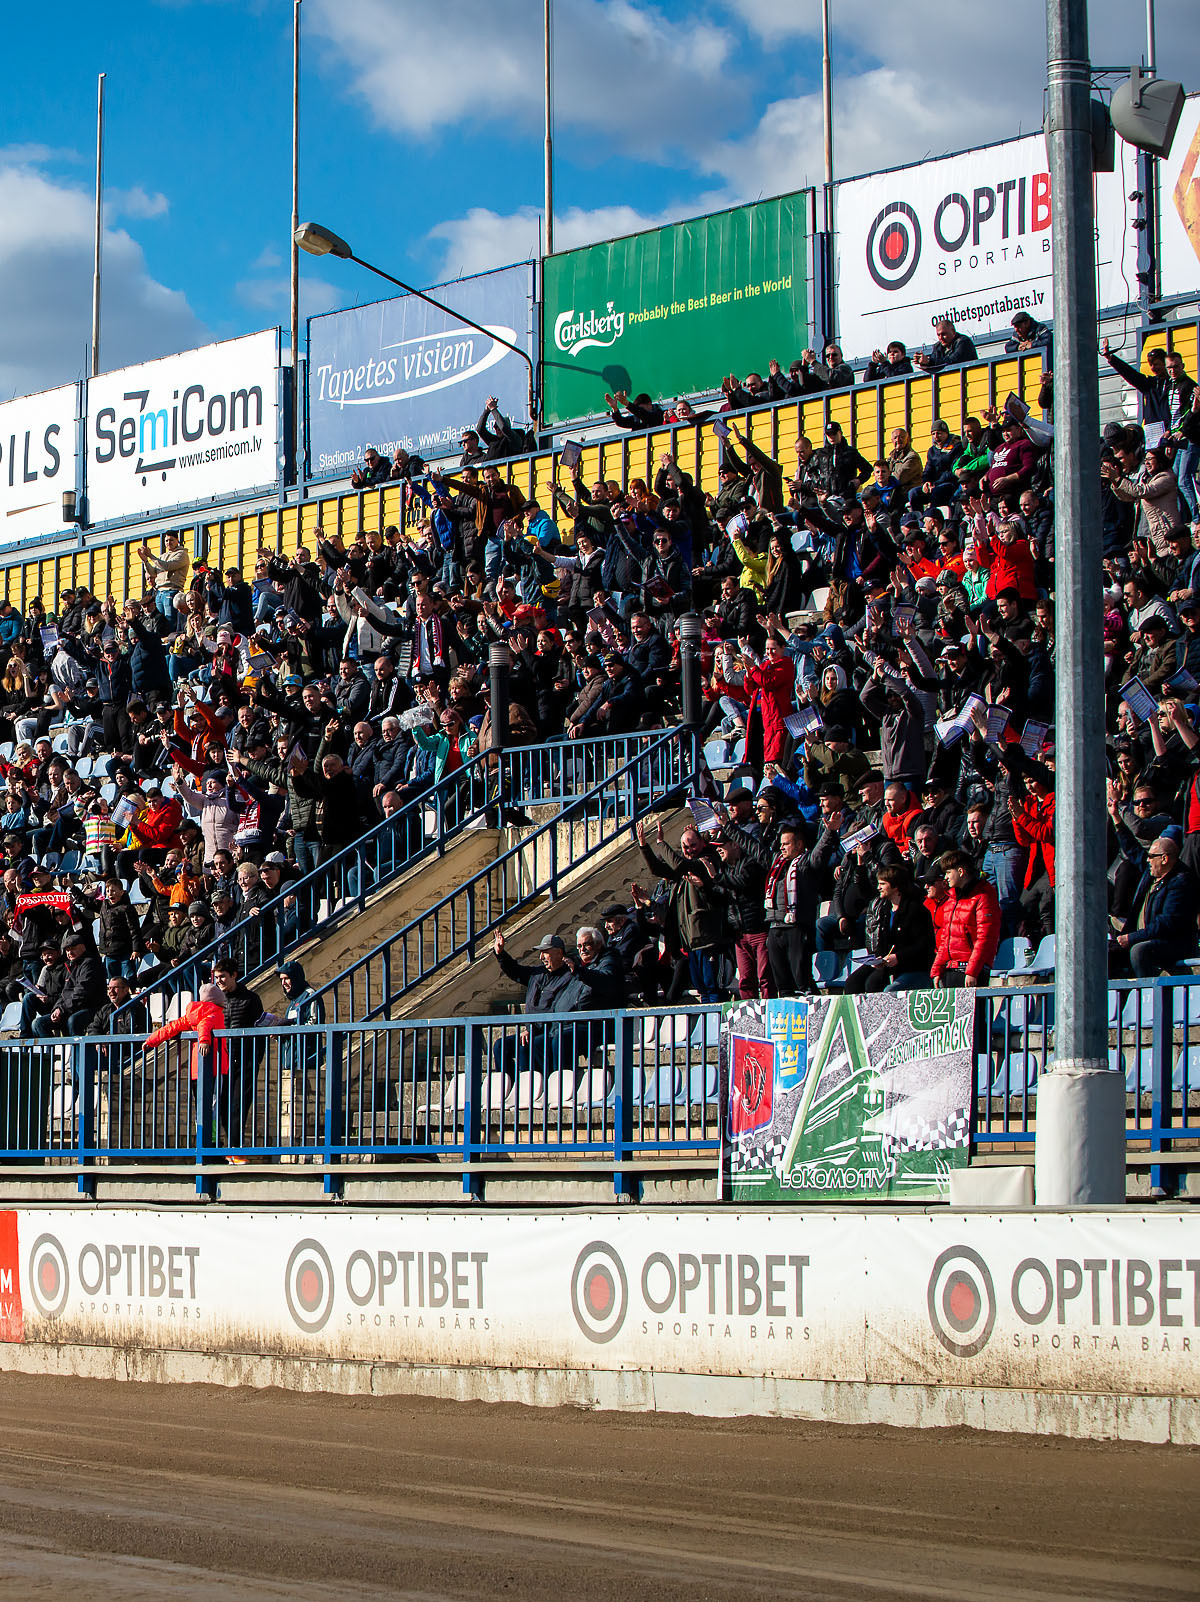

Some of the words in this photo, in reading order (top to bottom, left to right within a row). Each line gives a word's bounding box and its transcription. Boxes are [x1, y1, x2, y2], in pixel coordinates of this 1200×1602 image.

[934, 172, 1052, 252] OPTIB
[938, 244, 1024, 276] SPORTA
[1042, 228, 1100, 253] BS
[628, 307, 669, 325] Probably
[670, 300, 686, 315] the
[687, 295, 707, 311] Best
[710, 291, 731, 306] Beer
[733, 287, 743, 300] in
[744, 283, 760, 298] the
[762, 275, 792, 293] World
[931, 289, 1045, 328] optibetsportabars.lv
[554, 306, 625, 354] Carlsberg
[317, 350, 396, 410] Tapetes
[404, 338, 474, 381] visiem
[95, 384, 263, 463] SemiCom
[179, 434, 262, 469] www.semicom.lv
[319, 450, 355, 468] Stadiona
[913, 990, 950, 1024] 52
[931, 1016, 969, 1057] TRACK
[780, 1168, 888, 1189] LOKOMOTIV
[78, 1243, 200, 1300] OPTIBET
[345, 1249, 489, 1309] OPTIBET
[641, 1251, 810, 1317] OPTIBET
[1011, 1257, 1200, 1327] OPTIBET
[79, 1302, 142, 1318] SPORTA
[157, 1300, 201, 1319] BĀRS
[346, 1312, 426, 1329] SPORTA
[439, 1311, 491, 1331] BĀRS
[642, 1320, 733, 1339] SPORTA
[750, 1320, 811, 1341] BĀRS
[1013, 1333, 1121, 1352] SPORTA
[1141, 1332, 1192, 1352] BĀR
